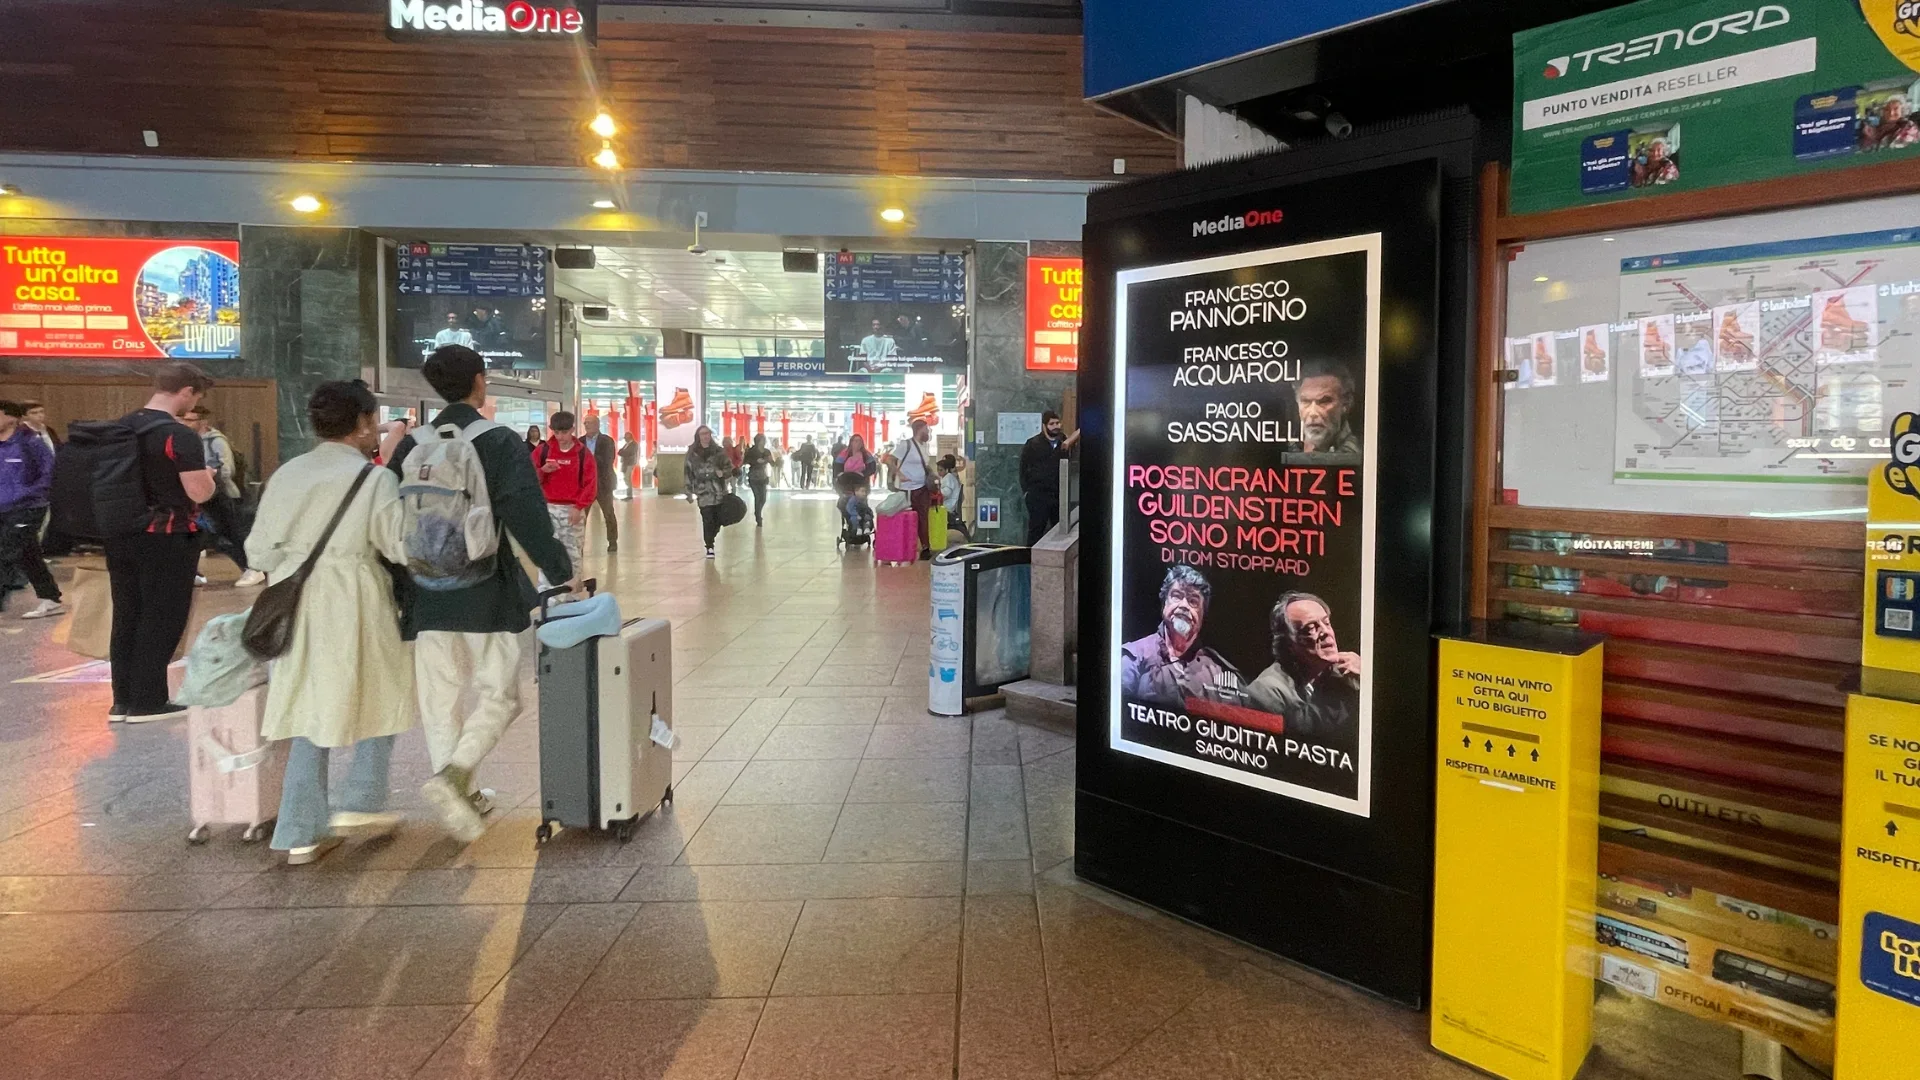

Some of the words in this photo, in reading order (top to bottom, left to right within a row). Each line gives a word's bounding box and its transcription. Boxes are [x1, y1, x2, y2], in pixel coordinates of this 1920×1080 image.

[388, 0, 583, 33] MediaOne
[1573, 5, 1790, 72] TRENORD
[1543, 99, 1588, 117] PUNTO
[1591, 85, 1652, 106] VENDITA
[1657, 66, 1737, 93] RESELLER
[1192, 209, 1284, 237] MediaOne
[3, 246, 66, 265] Tutta
[25, 264, 118, 283] un'altra
[16, 285, 81, 301] casa.
[1185, 280, 1289, 307] FRANCESCO
[1170, 298, 1307, 332] PANNOFINO
[125, 341, 146, 349] DILS
[1184, 341, 1288, 363] FRANCESCO
[1173, 360, 1300, 387] ACQUAROLI
[1205, 401, 1261, 419] PAOLO
[1167, 421, 1304, 443] SASSANELLI
[1129, 465, 1326, 495] ROSENCRANTZ
[1338, 469, 1356, 496] E
[1138, 492, 1342, 526] GUILDENSTERN
[1150, 520, 1228, 549] SONO
[1237, 525, 1325, 556] MORTI
[1161, 548, 1176, 563] DI
[1178, 549, 1213, 567] TOM
[1217, 553, 1310, 576] STOPPARD
[1452, 669, 1464, 679] SE
[1467, 671, 1492, 683] NON
[1496, 675, 1515, 687] HAI
[1518, 679, 1552, 693] VINTO
[1473, 686, 1505, 699] GETTA
[1508, 691, 1529, 703] QUI
[1456, 696, 1464, 705] IL
[1467, 698, 1489, 710] TUO
[1493, 702, 1547, 720] BIGLIETTO
[1128, 702, 1191, 732] TEATRO
[1196, 719, 1279, 756] GIUDITTA
[1285, 739, 1354, 772] PASTA
[1869, 734, 1888, 747] SE
[1196, 740, 1268, 769] SARONNO
[1446, 758, 1490, 775] RISPETTA
[1493, 768, 1557, 790] L'AMBIENTE
[1875, 769, 1888, 782] IL
[1657, 793, 1763, 825] OUTLETS
[1857, 846, 1920, 872] RISPETT
[1664, 985, 1724, 1014] OFFICIAL
